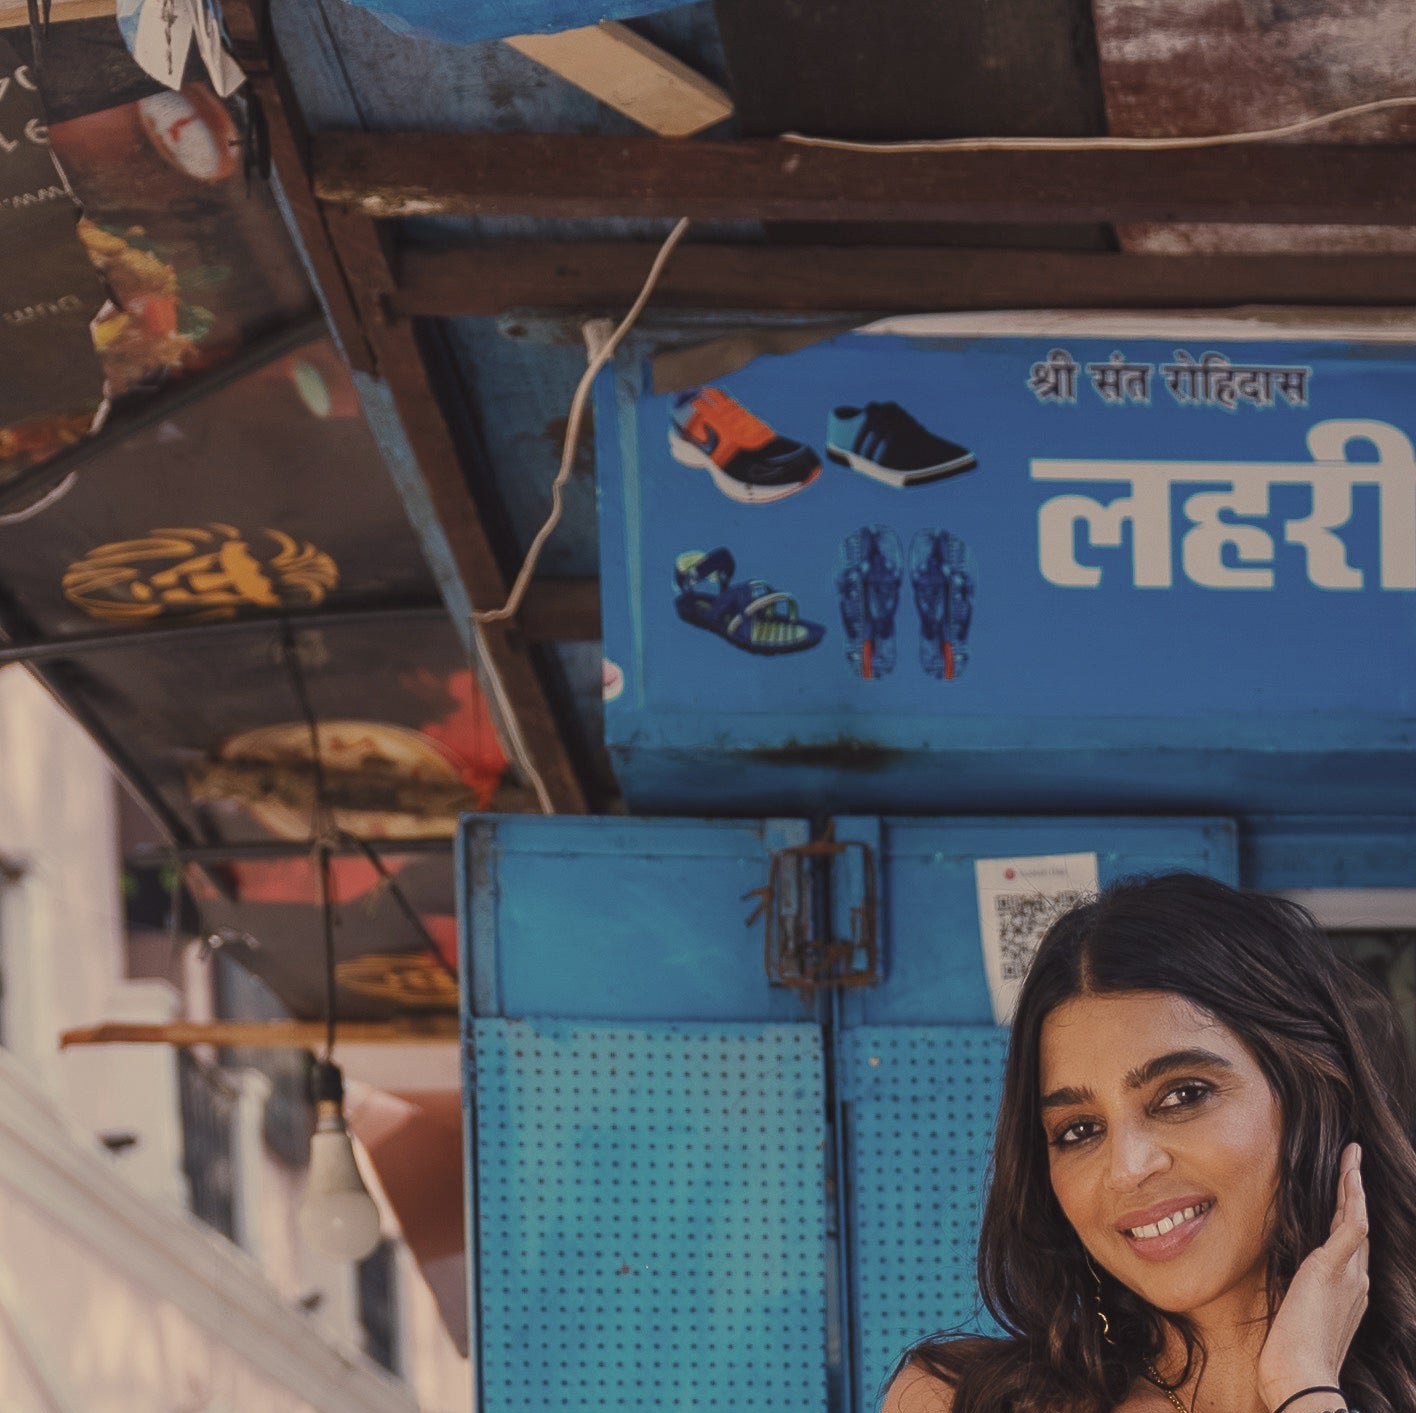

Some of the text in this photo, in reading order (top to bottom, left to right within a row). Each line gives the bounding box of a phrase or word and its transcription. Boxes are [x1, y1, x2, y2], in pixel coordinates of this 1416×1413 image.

[1028, 349, 1311, 410] श्री संत रोहिदास
